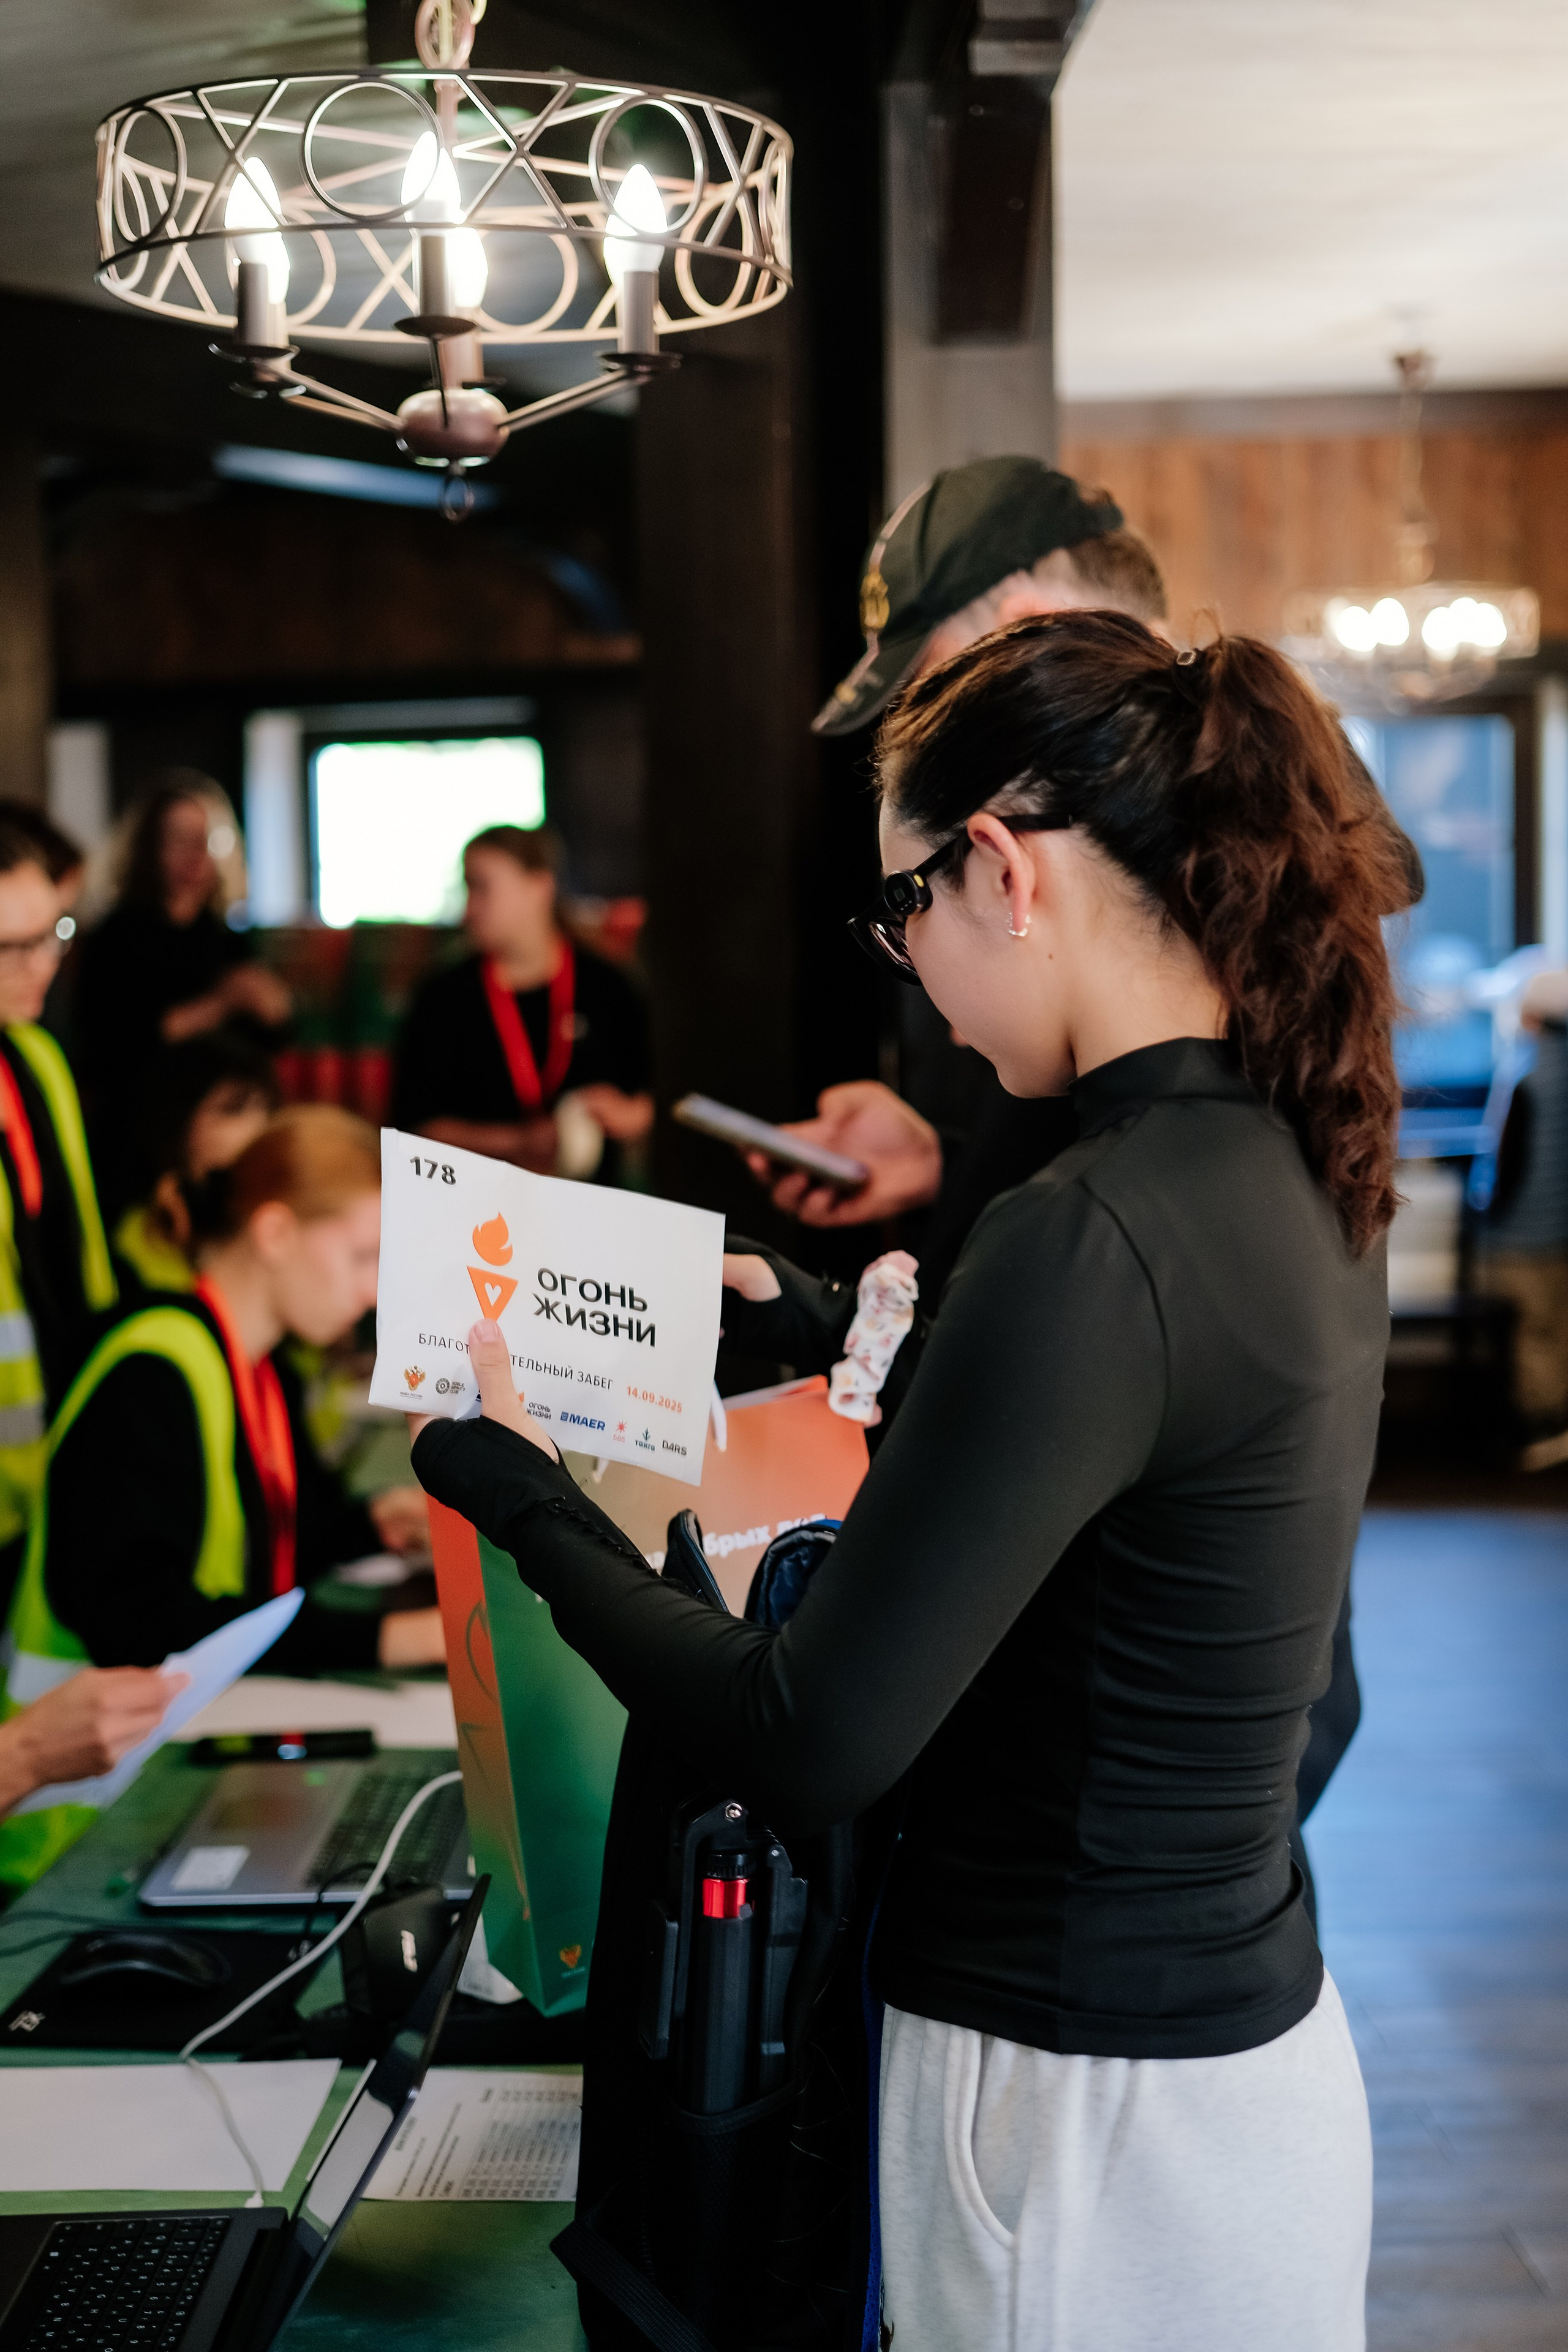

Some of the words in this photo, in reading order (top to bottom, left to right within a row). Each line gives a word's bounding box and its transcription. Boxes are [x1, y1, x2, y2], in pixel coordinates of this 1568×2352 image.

[410, 1155, 456, 1185] 178
[537, 1267, 648, 1312] ОГОНЬ
[532, 1292, 656, 1348] ЖИЗНИ
[418, 1332, 573, 1380] БЛАГОТТЕЛЬНЫЙ
[577, 1370, 614, 1390] ЗАБЕГ
[529, 1401, 551, 1413] ОГОНЬ
[627, 1385, 683, 1414] 14.09.2025
[568, 1413, 606, 1431] MAER
[662, 1439, 687, 1457] DARS
